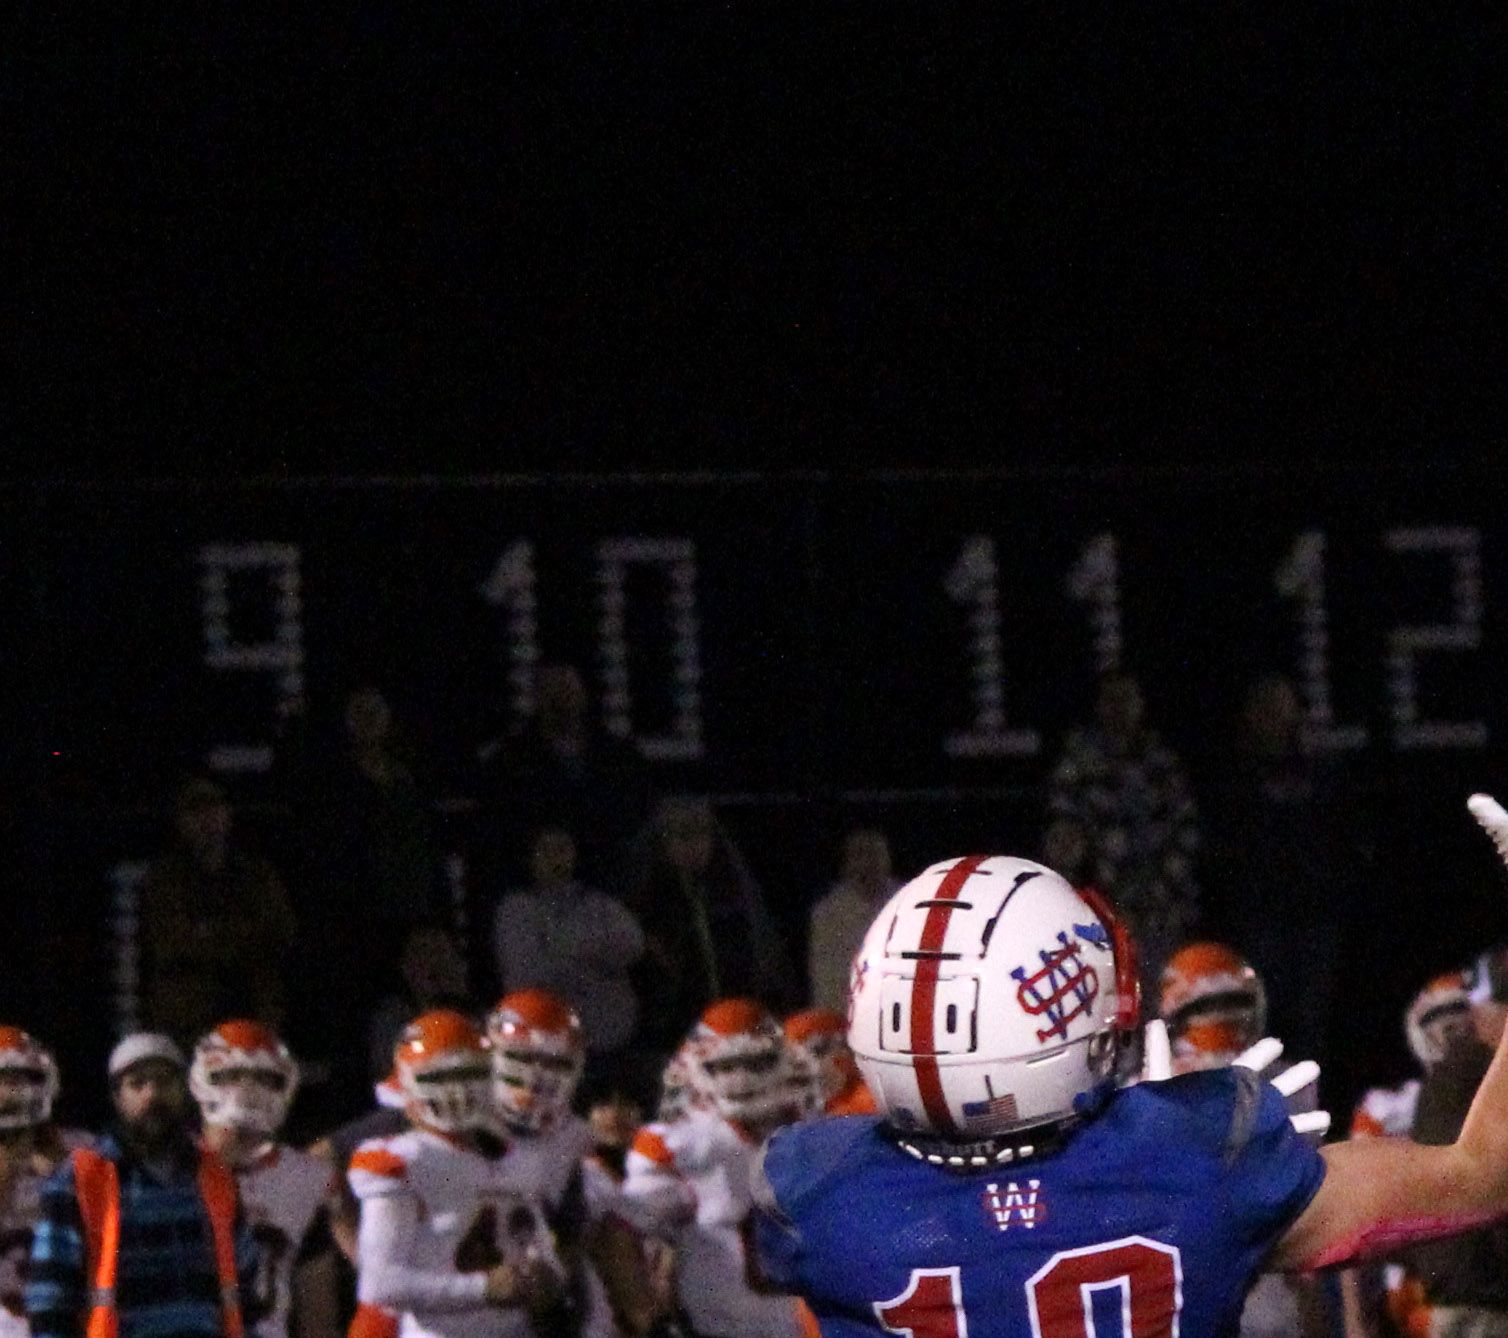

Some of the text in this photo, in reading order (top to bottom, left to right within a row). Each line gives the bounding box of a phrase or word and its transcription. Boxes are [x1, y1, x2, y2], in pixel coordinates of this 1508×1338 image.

[201, 540, 304, 774] 9
[478, 536, 704, 760] 10
[942, 530, 1124, 759] 11
[1272, 523, 1489, 751] 12
